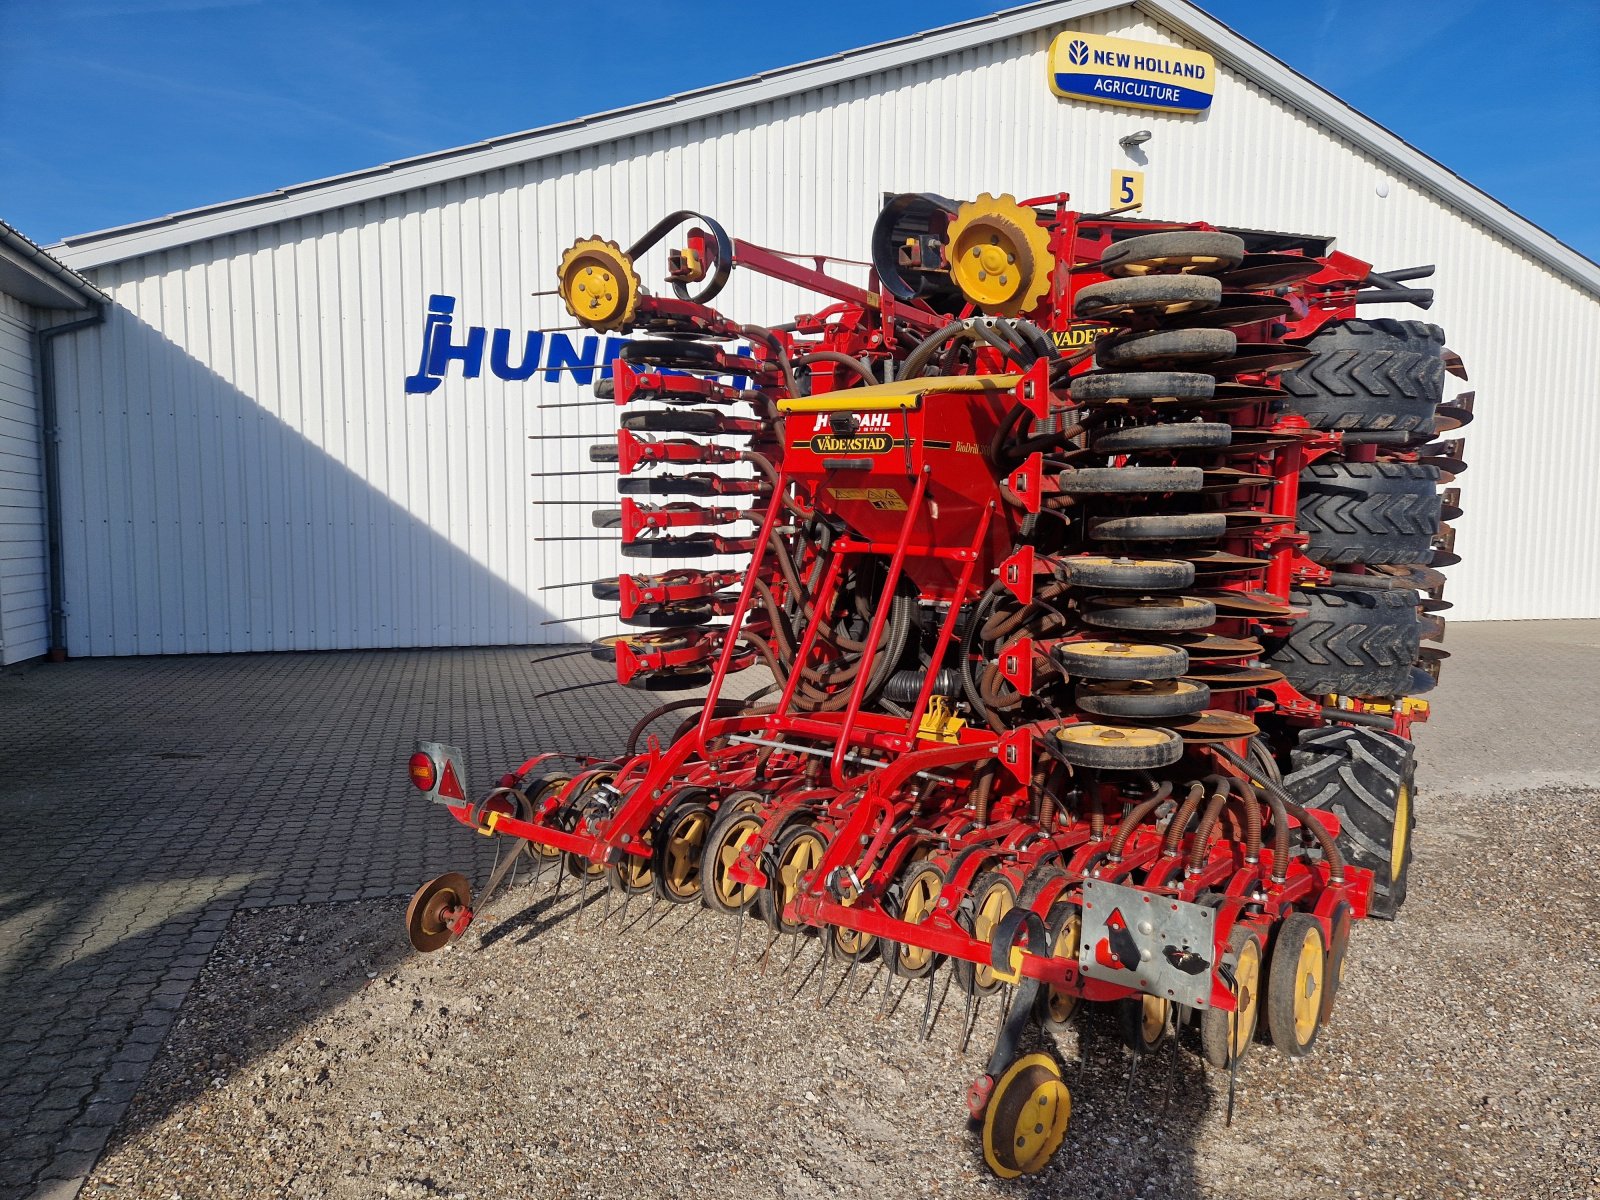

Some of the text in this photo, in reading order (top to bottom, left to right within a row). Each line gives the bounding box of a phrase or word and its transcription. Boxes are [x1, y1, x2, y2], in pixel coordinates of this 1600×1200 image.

[1093, 49, 1206, 80] NEW HOLLAND
[1094, 78, 1180, 102] AGRICULTURE
[1119, 175, 1134, 203] 5
[817, 436, 885, 451] VÄDERSTAD
